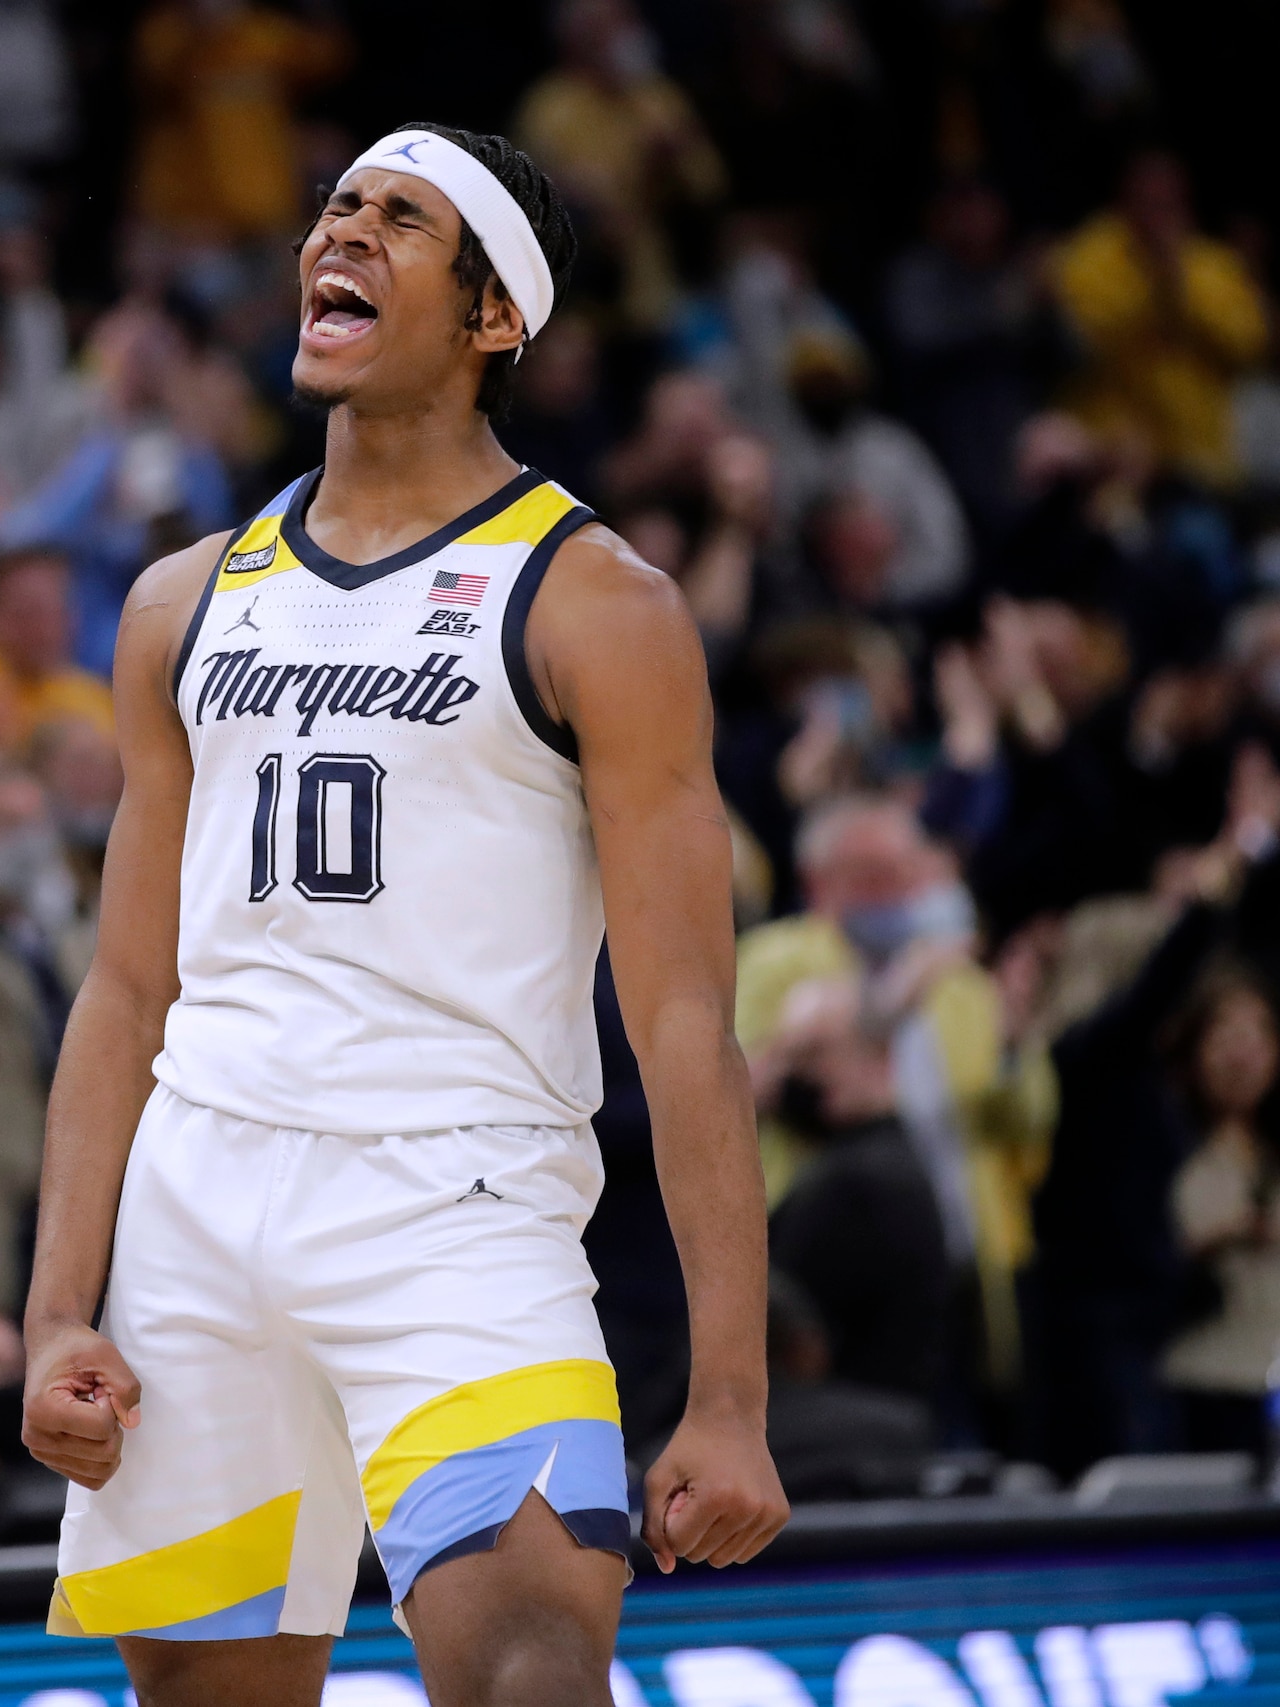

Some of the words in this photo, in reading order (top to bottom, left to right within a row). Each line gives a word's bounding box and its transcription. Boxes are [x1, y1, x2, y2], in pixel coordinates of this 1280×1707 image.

[421, 620, 482, 634] EAST
[430, 609, 472, 622] BIG
[196, 648, 480, 737] Marquette
[249, 753, 387, 904] 10
